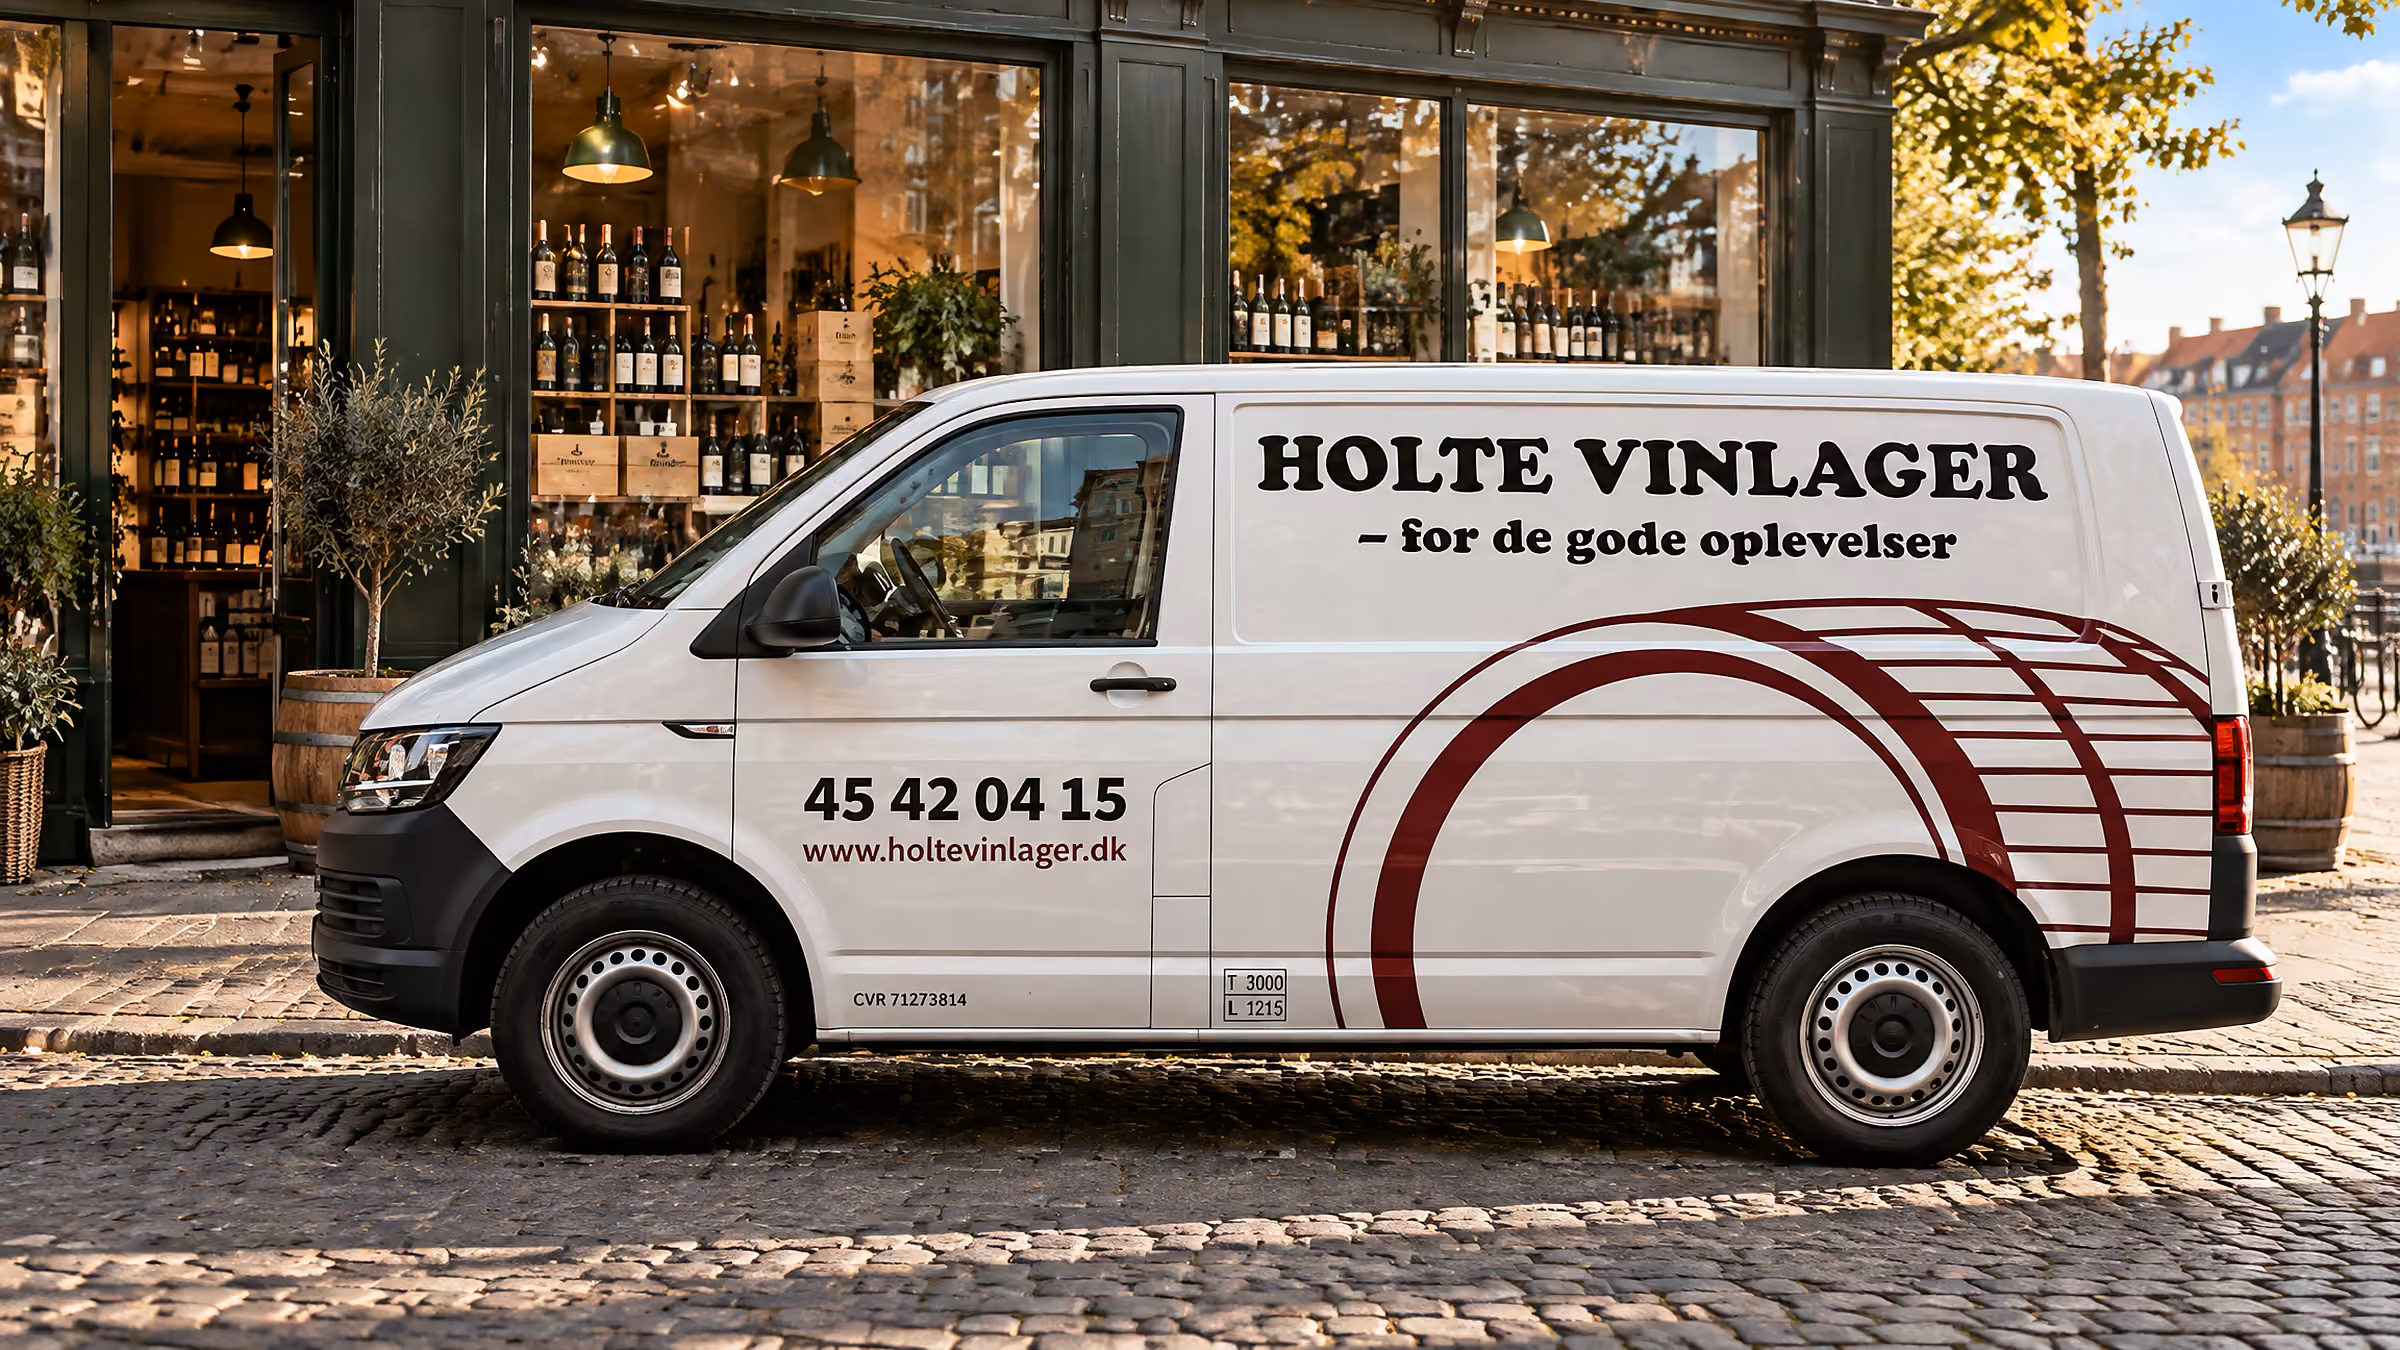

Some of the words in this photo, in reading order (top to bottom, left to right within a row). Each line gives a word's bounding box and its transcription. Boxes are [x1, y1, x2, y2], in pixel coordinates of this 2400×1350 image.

[1257, 434, 1553, 495] HOLTE
[1573, 437, 2049, 502] VINLAGER
[1401, 517, 1480, 554] for
[1492, 519, 1552, 555] de
[1566, 521, 1687, 565] gode
[1699, 522, 1958, 566] oplevelser
[803, 776, 875, 822] 45
[890, 776, 959, 821] 42
[975, 776, 1046, 822] 04
[1061, 777, 1127, 822] 15
[802, 835, 1127, 870] www.holtevinlager.dk
[853, 992, 887, 1007] CVR
[890, 992, 968, 1007] 71273814
[1227, 974, 1238, 991] T
[1245, 974, 1284, 992] 3000
[1227, 1000, 1239, 1017] L
[1246, 1000, 1284, 1017] 1215
